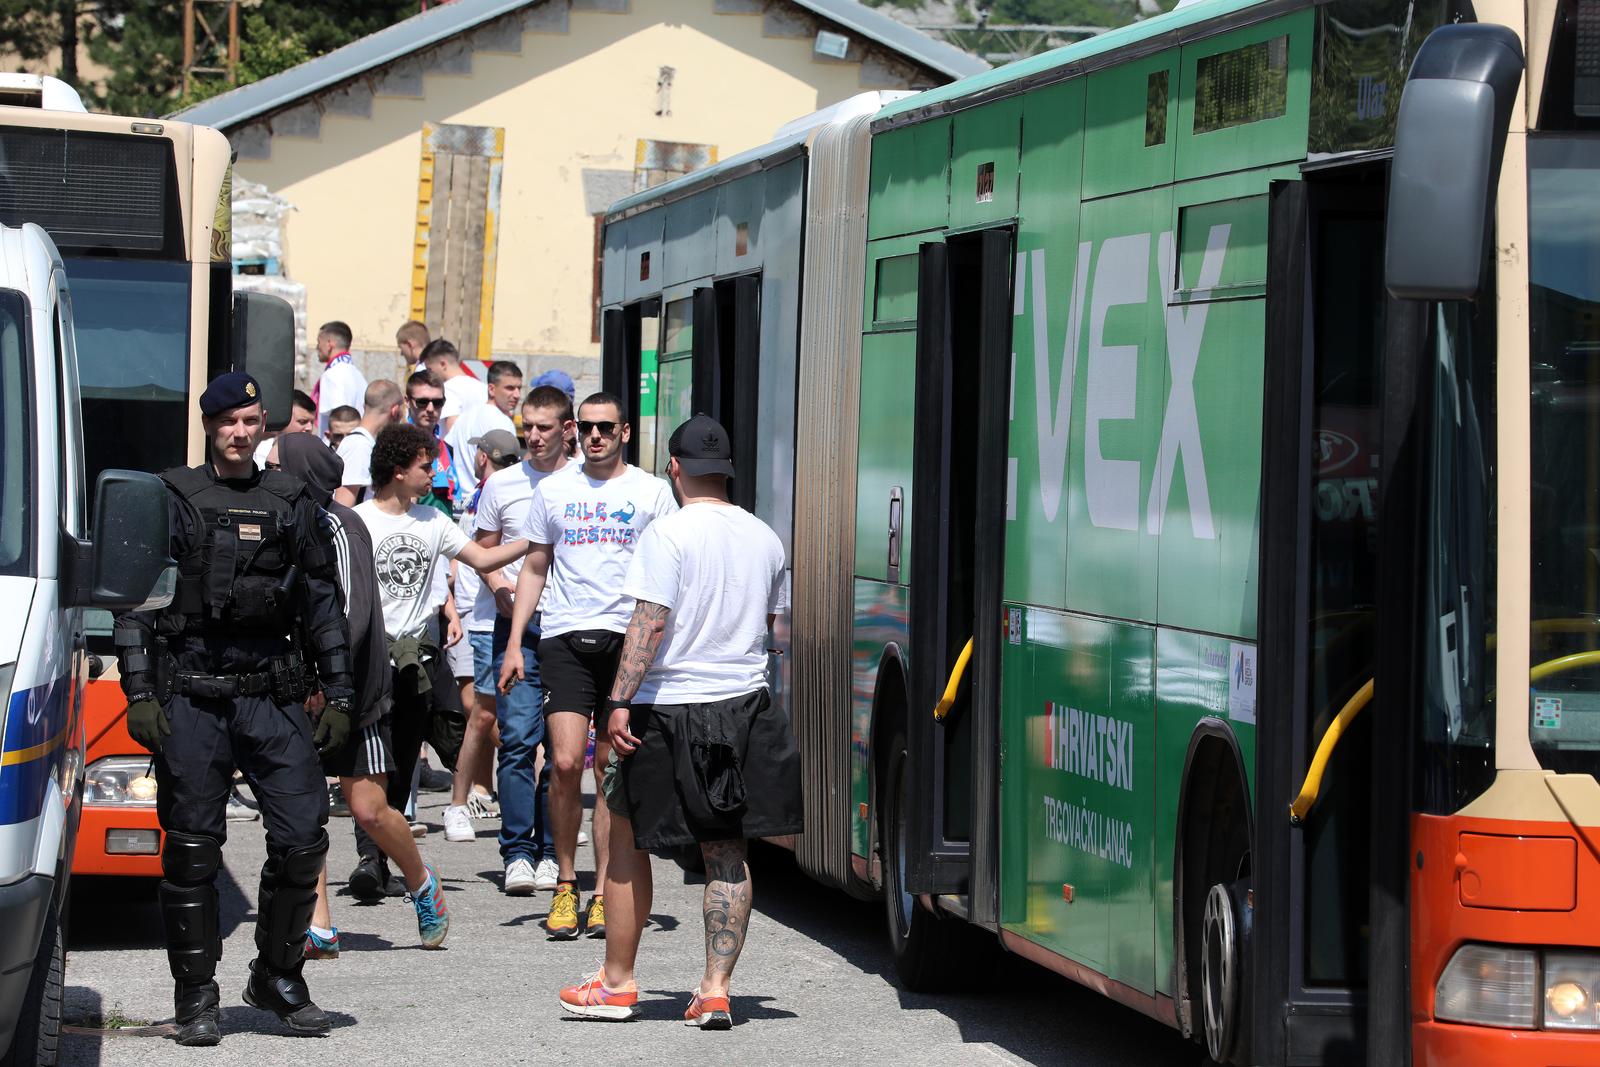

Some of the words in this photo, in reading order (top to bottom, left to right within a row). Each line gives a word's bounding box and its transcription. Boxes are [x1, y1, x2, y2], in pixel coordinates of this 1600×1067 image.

[564, 501, 608, 523] BILE
[377, 535, 404, 561] WHITE
[404, 535, 430, 559] BOYS
[1044, 795, 1097, 856] TRGOVAČKI
[1099, 813, 1133, 869] LANAC
